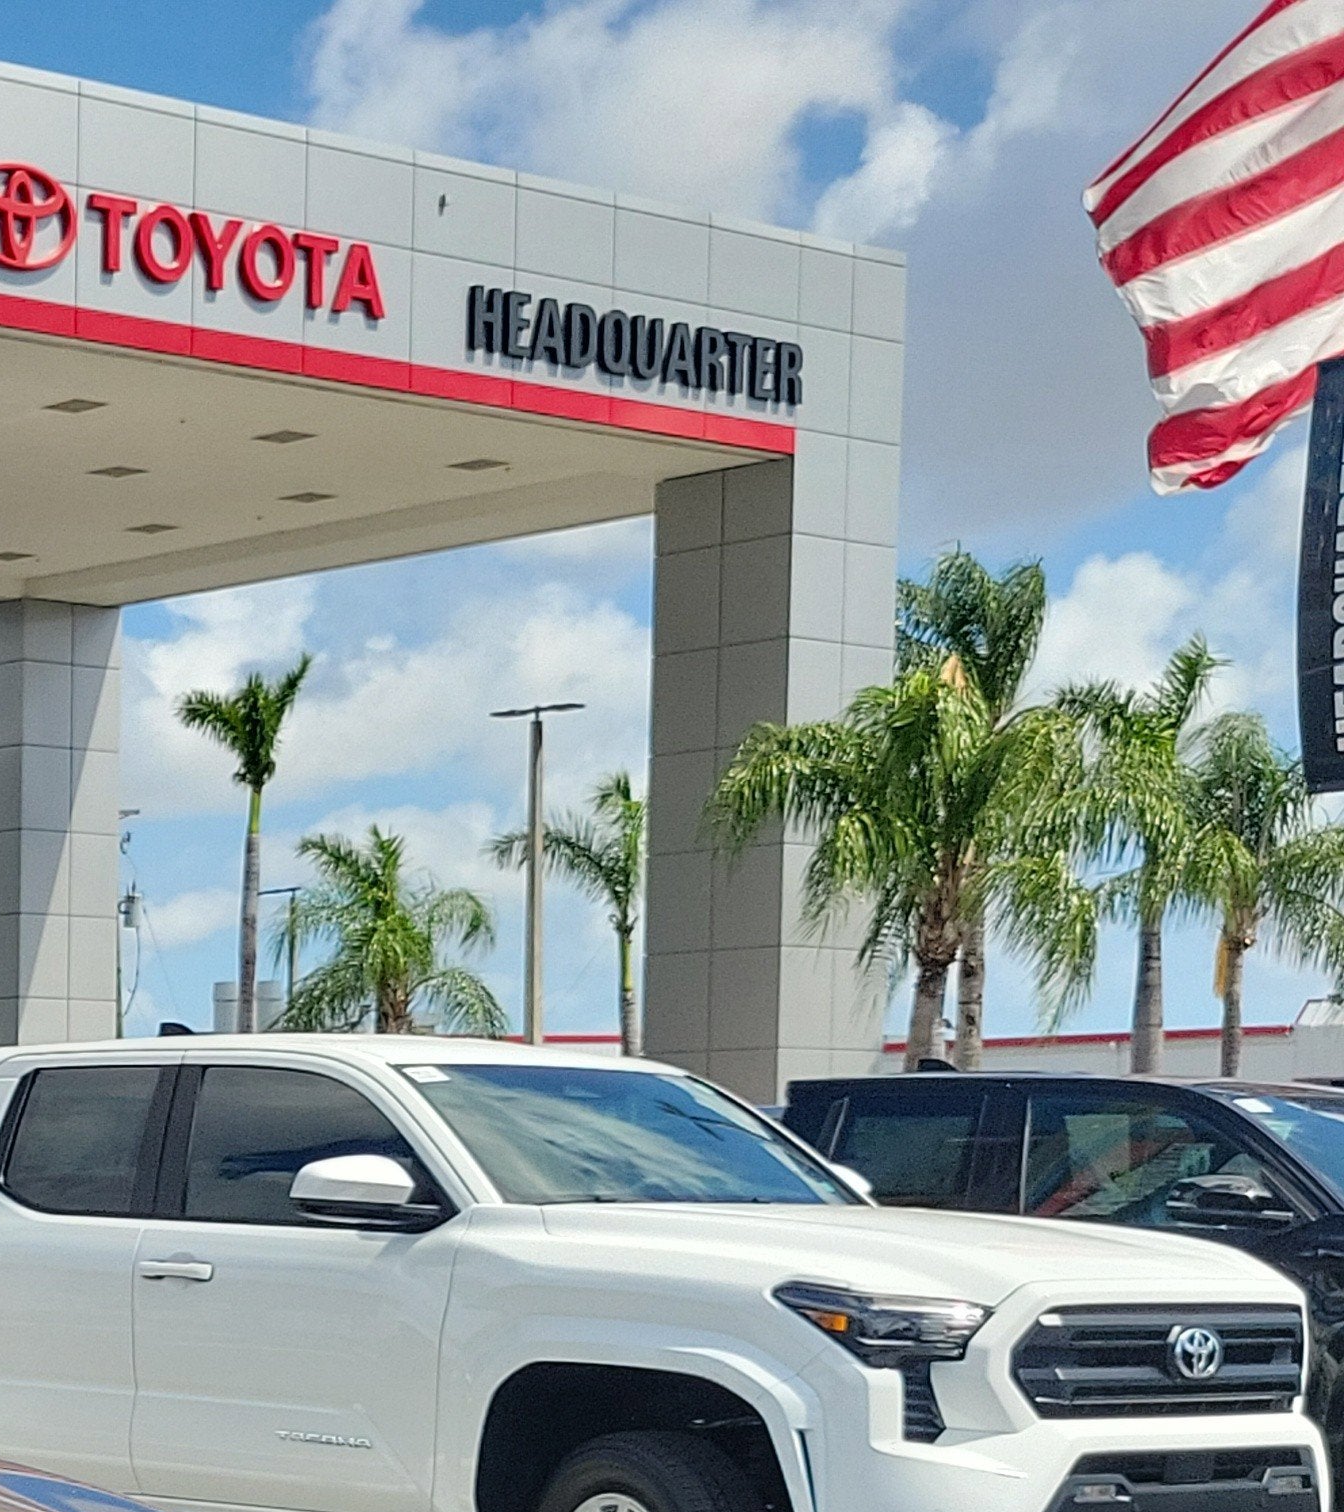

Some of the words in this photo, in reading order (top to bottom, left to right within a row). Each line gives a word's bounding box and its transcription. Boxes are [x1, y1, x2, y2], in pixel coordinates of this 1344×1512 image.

[88, 194, 387, 320] TOYOTA
[466, 285, 804, 404] HEADQUARTER
[275, 1430, 372, 1449] TACOMA
